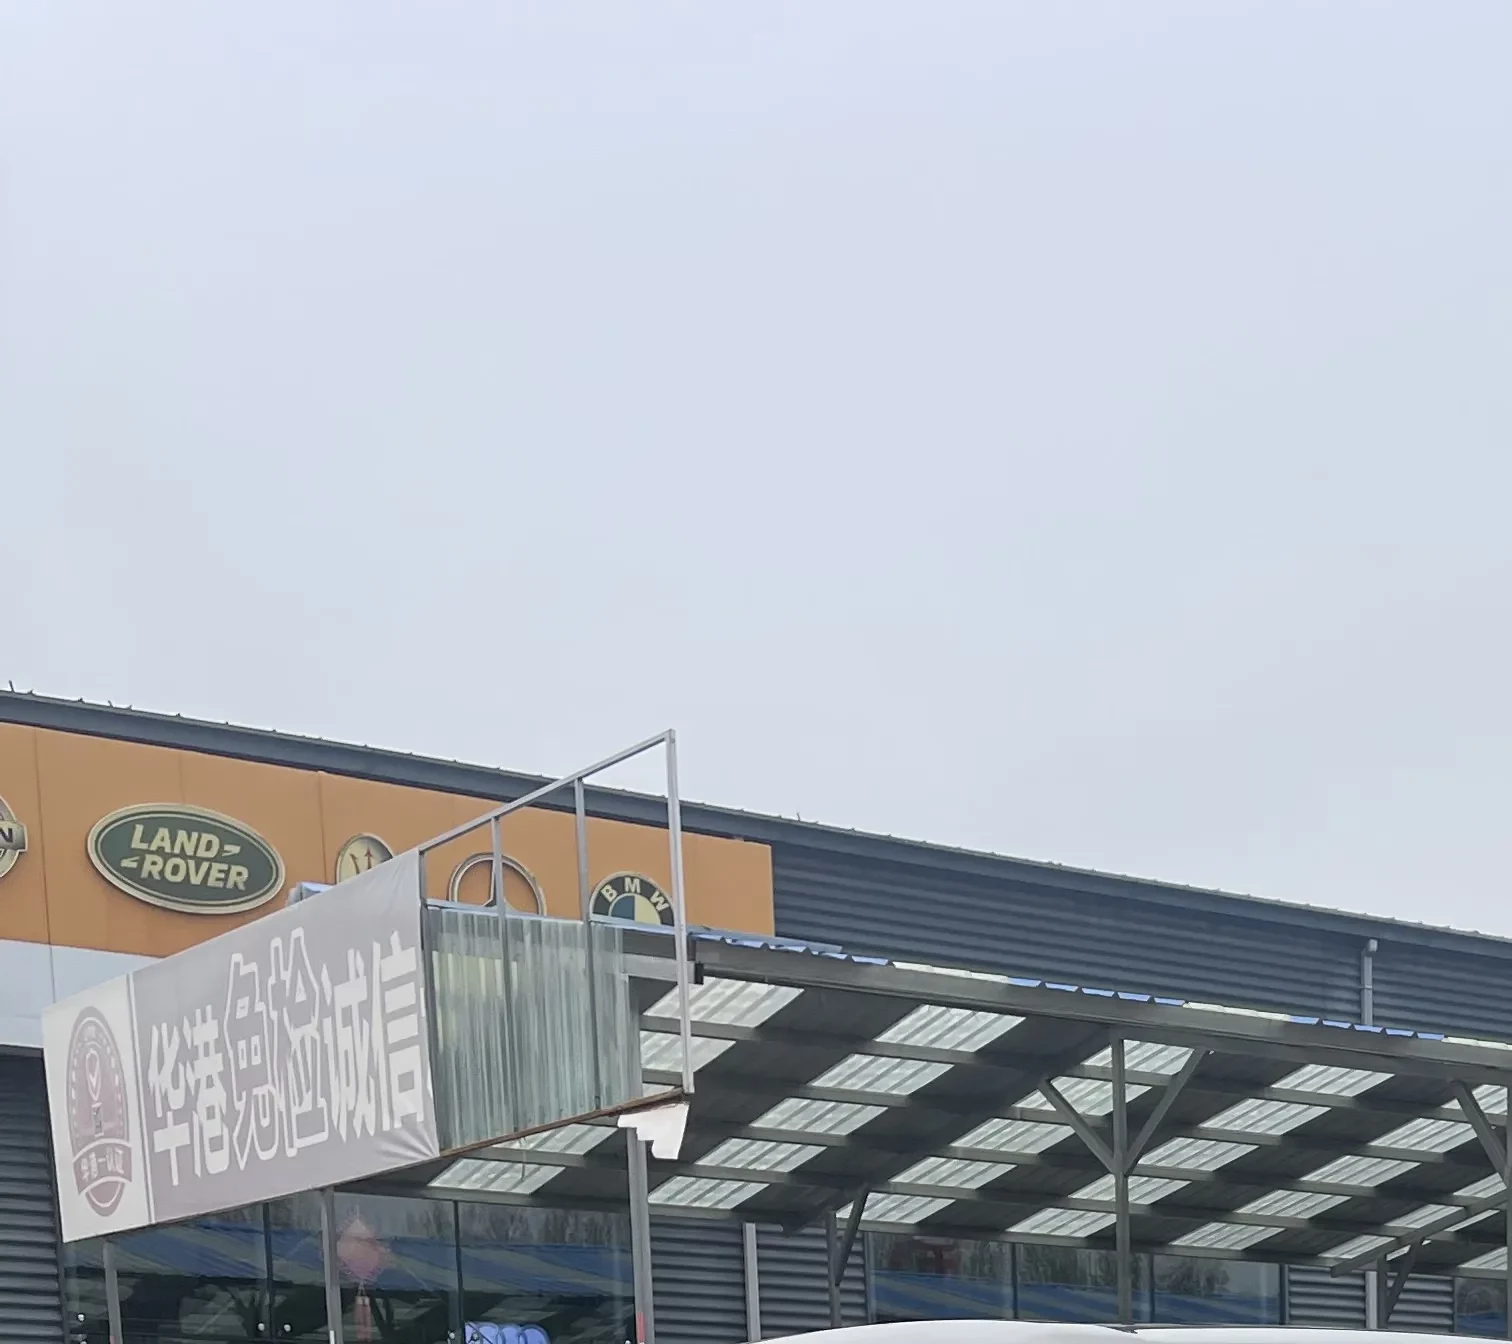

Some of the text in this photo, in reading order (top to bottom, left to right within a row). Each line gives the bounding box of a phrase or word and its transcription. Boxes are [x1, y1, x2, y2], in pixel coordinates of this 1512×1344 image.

[130, 824, 220, 858] LAND
[140, 853, 249, 890] ROVER
[600, 876, 669, 912] BMW
[149, 926, 432, 1186] 华港免检诚信
